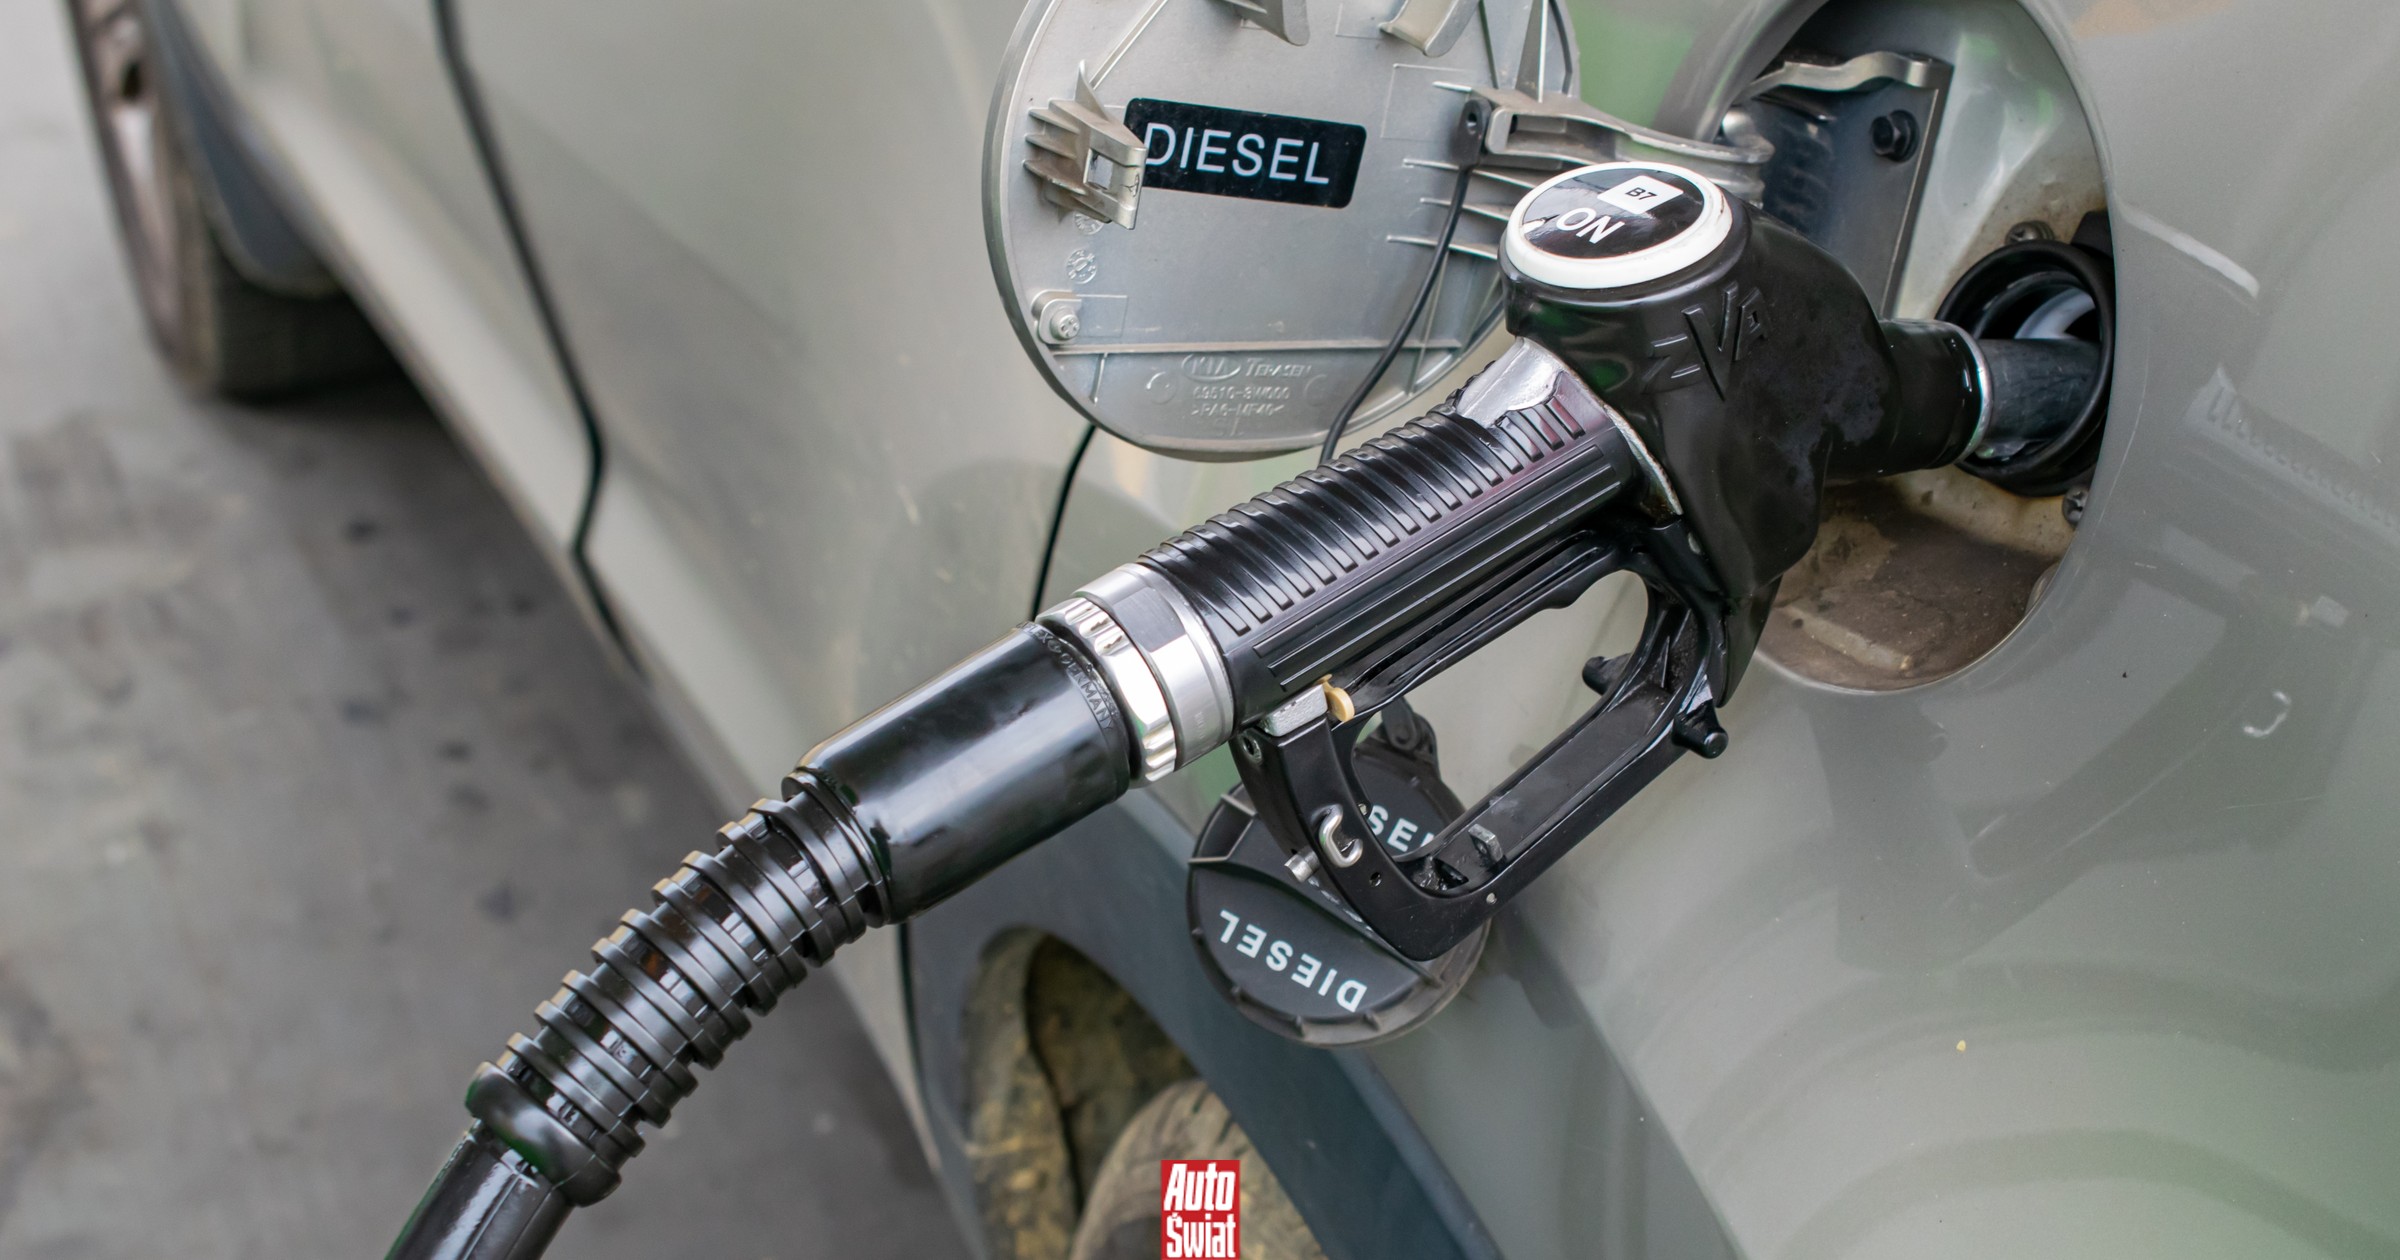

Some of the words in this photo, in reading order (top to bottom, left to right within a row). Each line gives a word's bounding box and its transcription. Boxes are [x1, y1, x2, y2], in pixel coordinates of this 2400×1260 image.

[1144, 122, 1330, 185] DIESEL
[1625, 187, 1657, 201] B7
[1556, 207, 1626, 244] ON
[1219, 909, 1368, 1013] DIESEL
